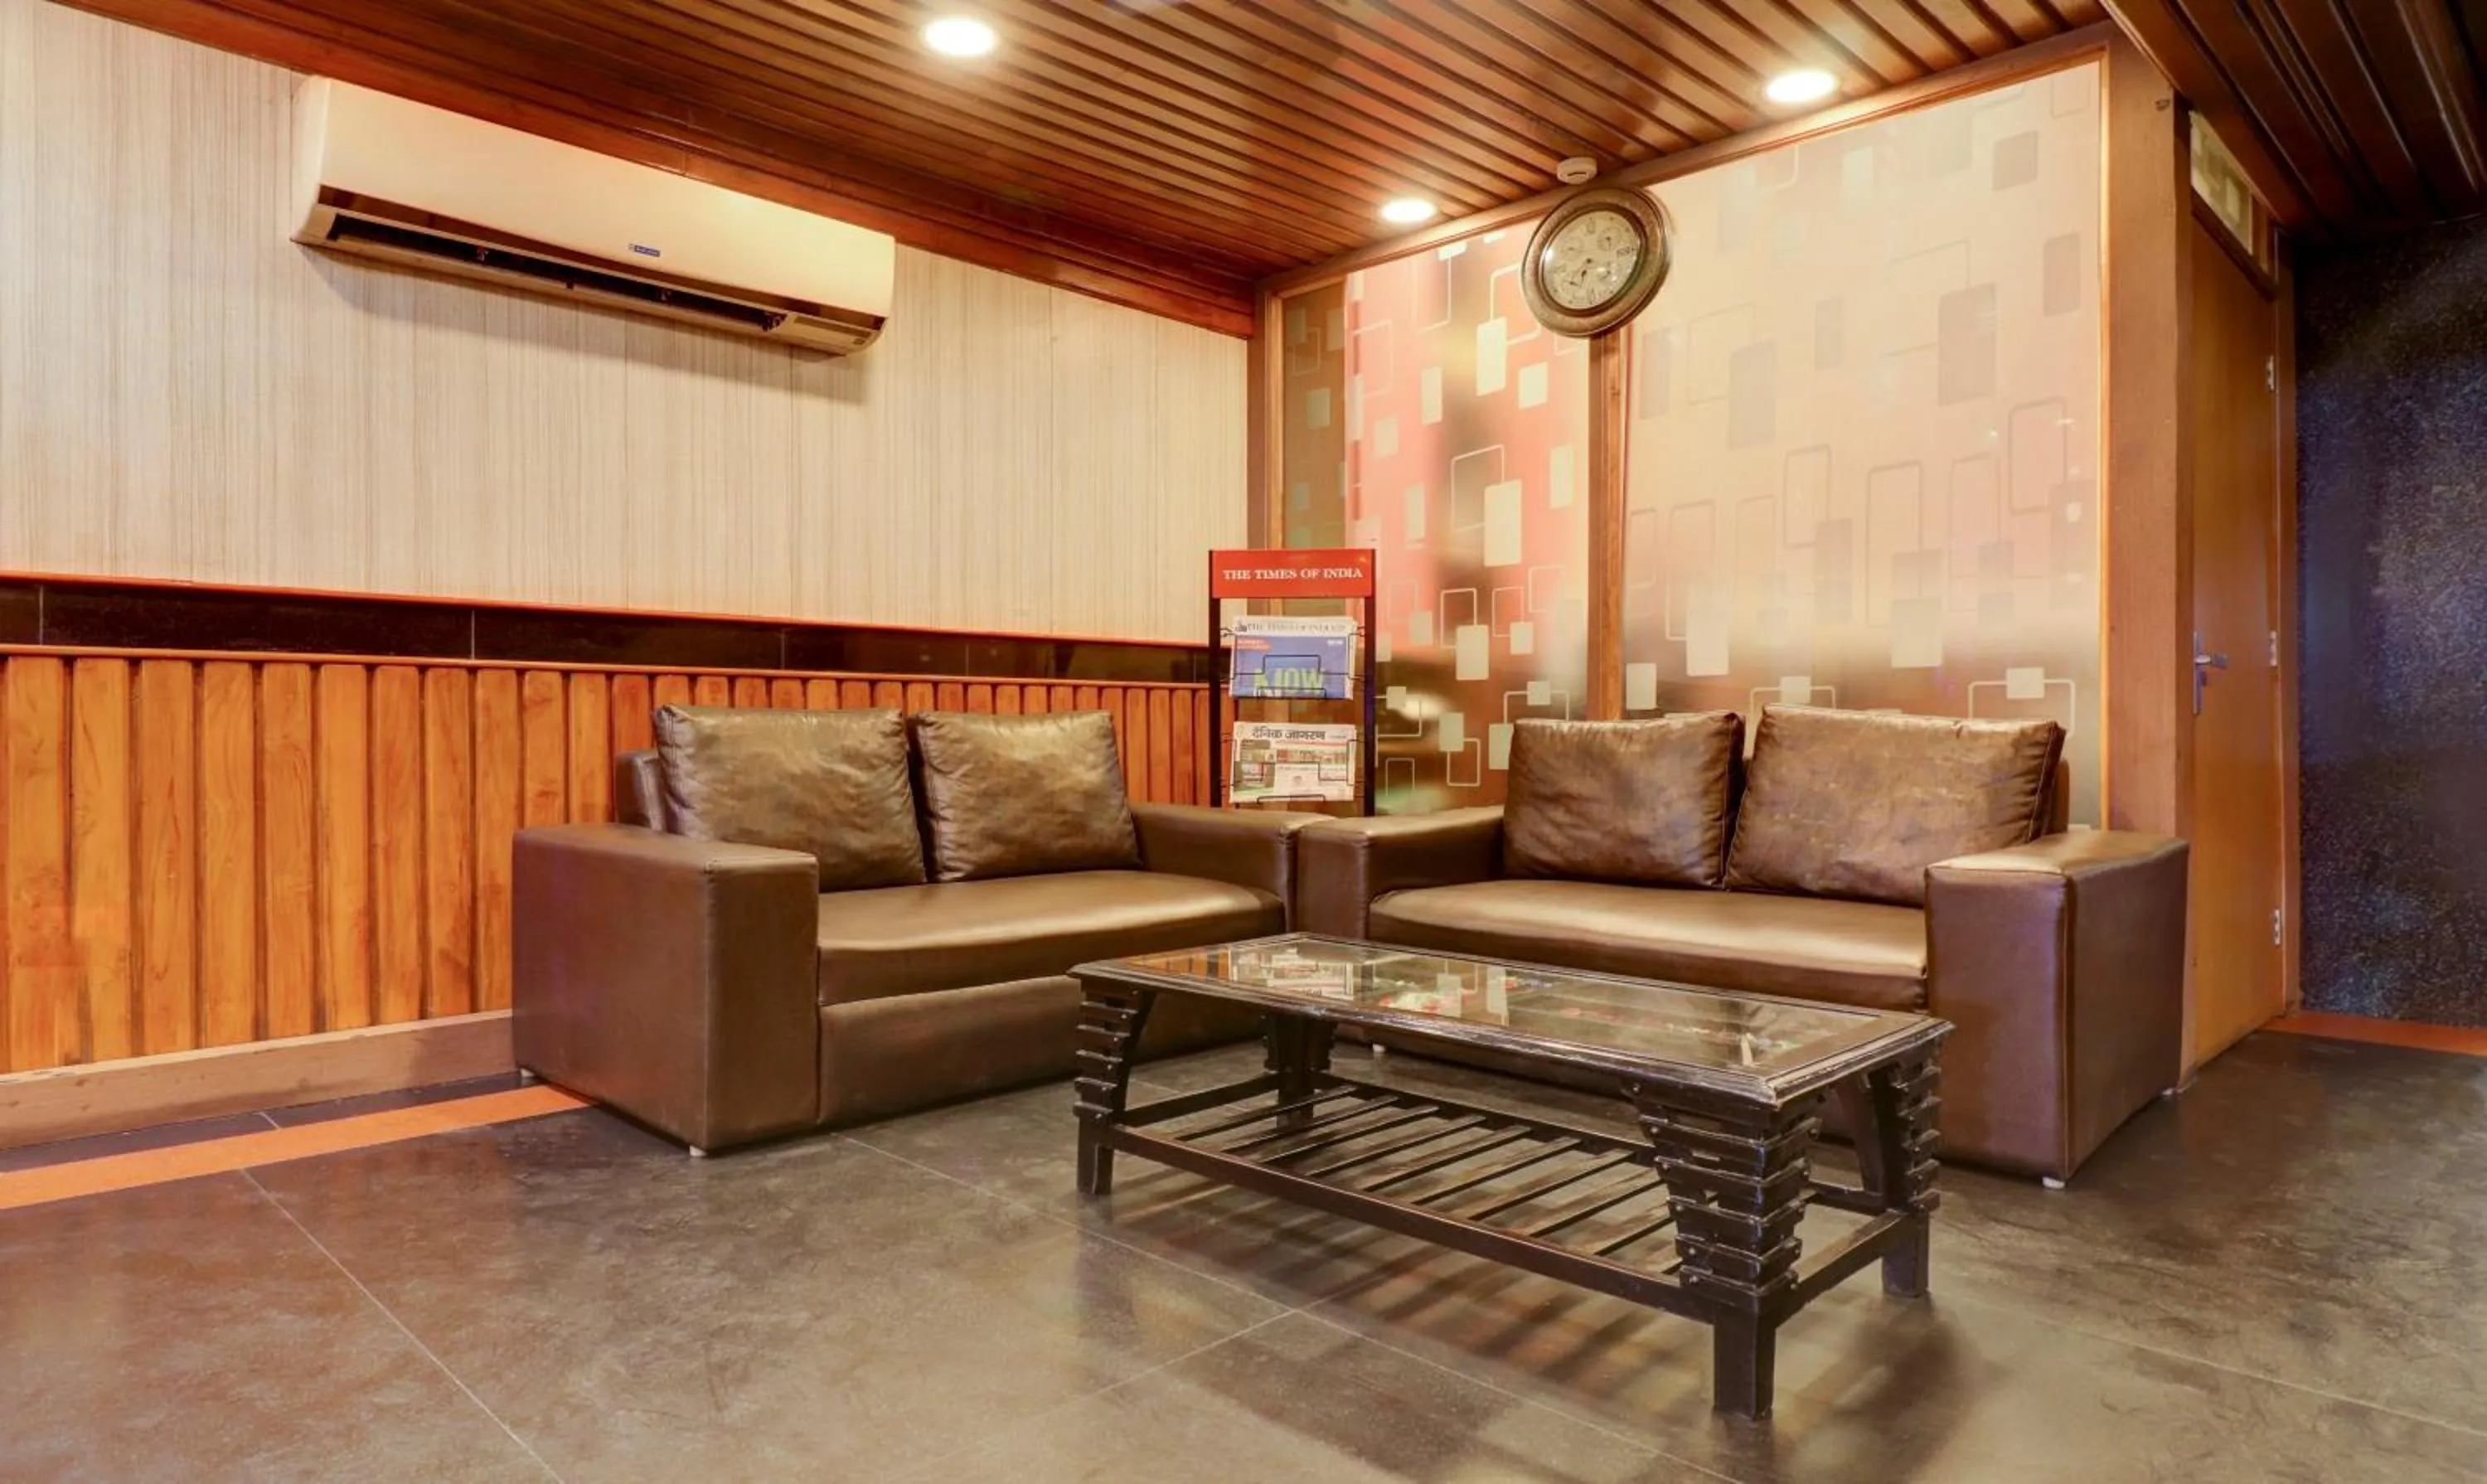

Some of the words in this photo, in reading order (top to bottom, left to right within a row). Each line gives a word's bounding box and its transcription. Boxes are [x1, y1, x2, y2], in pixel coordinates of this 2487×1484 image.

[1223, 569, 1251, 580] THE
[1253, 569, 1297, 580] TIMES
[1300, 568, 1320, 579] OF
[1323, 567, 1364, 579] INDIA
[1252, 726, 1282, 739] दैनिक
[1284, 730, 1326, 740] जागरण
